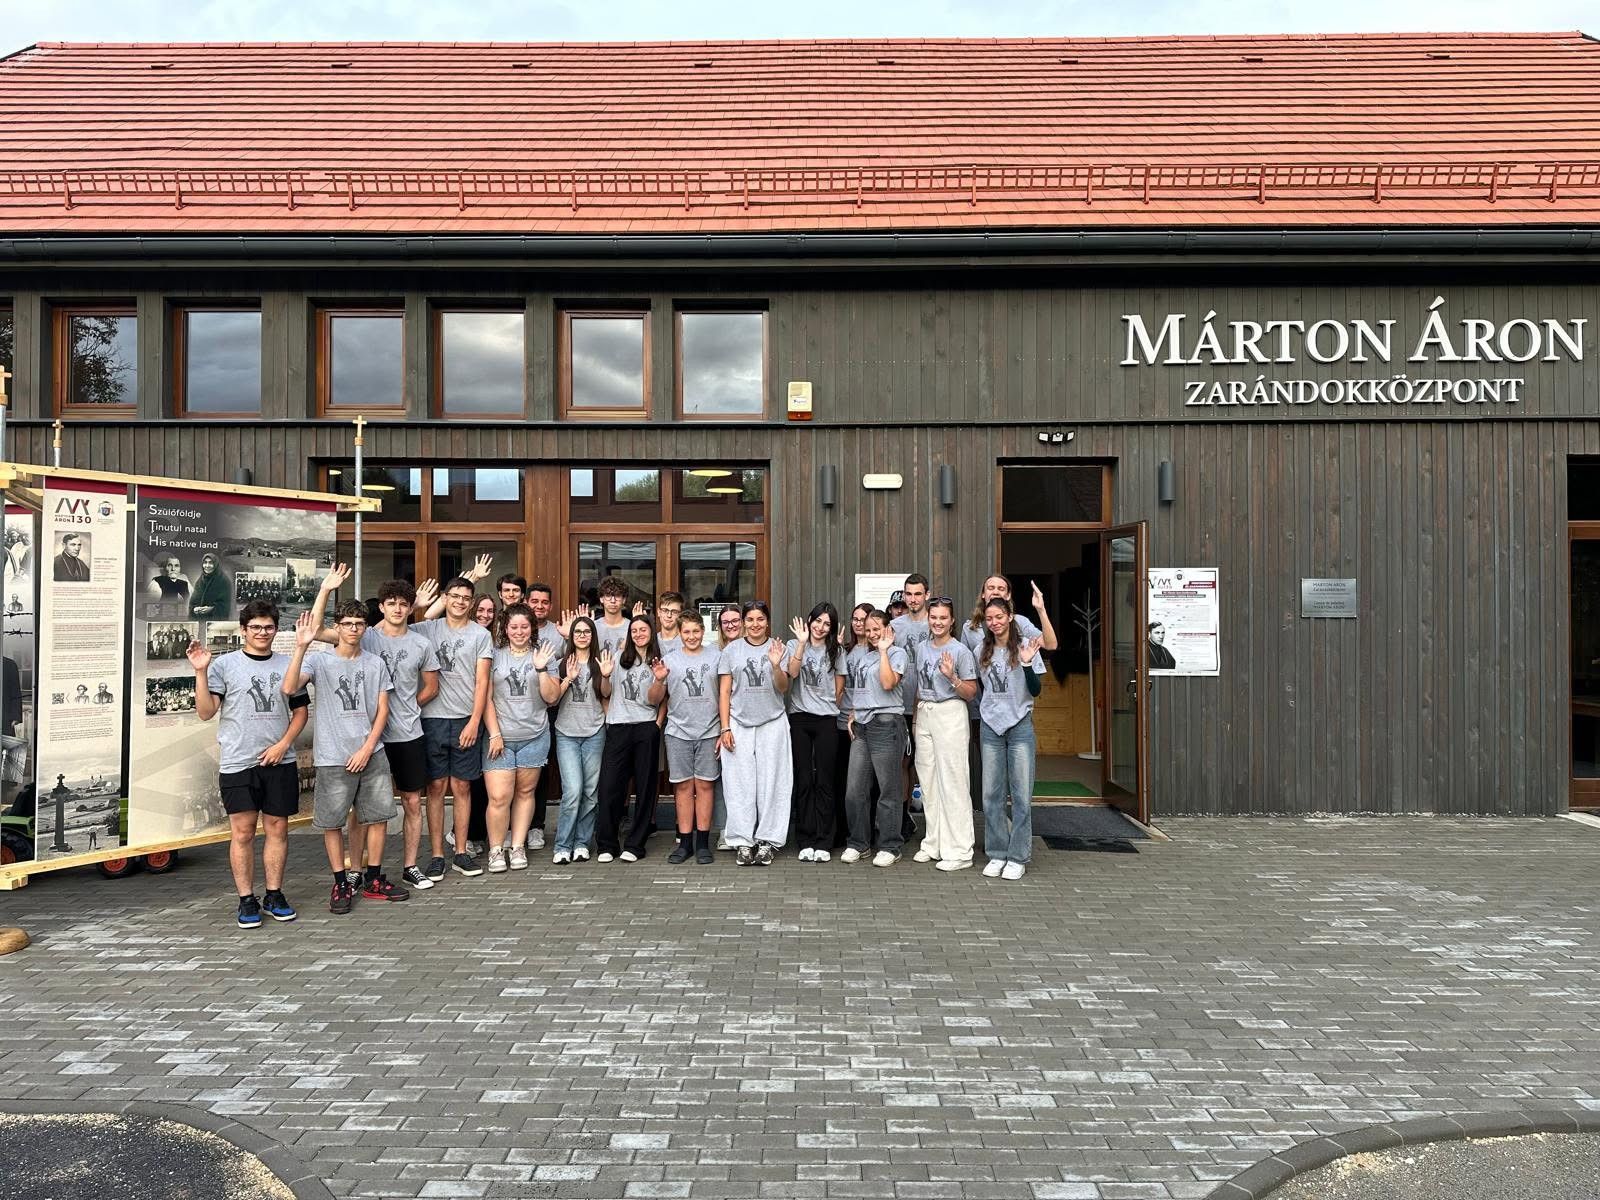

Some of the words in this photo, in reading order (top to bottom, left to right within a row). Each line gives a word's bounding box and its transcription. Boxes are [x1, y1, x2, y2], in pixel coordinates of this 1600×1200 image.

[1120, 309, 1396, 366] MÁRTON
[1407, 295, 1588, 364] ÁRON
[1184, 374, 1525, 407] ZARÁNDOKKÖZPONT
[149, 504, 201, 519] Szülőföldje
[71, 515, 92, 524] 130
[184, 525, 207, 534] natal
[149, 535, 167, 547] His
[169, 539, 197, 548] native
[199, 540, 218, 549] land
